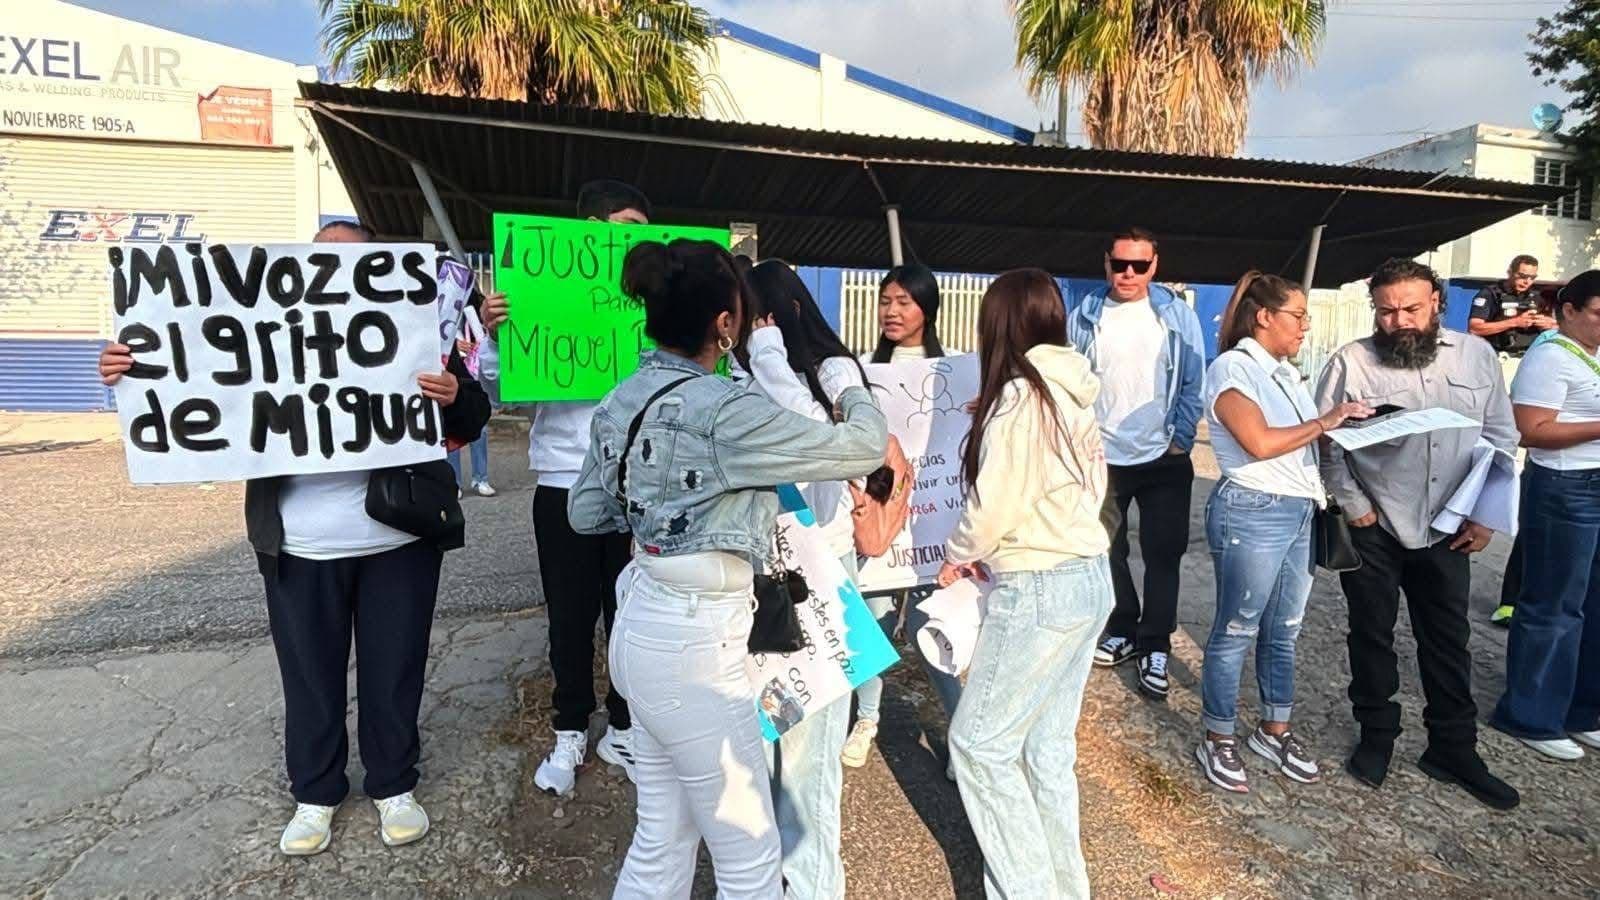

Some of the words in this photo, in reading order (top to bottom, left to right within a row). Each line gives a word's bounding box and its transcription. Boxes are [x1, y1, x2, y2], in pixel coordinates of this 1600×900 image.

[0, 36, 100, 80] XEL
[110, 44, 182, 87] AIR
[3, 110, 86, 130] NOVIEMBRE
[40, 209, 208, 243] EXEL
[353, 250, 438, 305] es
[117, 321, 189, 383] el
[201, 308, 400, 386] grito
[507, 319, 619, 389] Miguel
[130, 388, 231, 453] de
[824, 629, 840, 648] en
[788, 667, 812, 706] con
